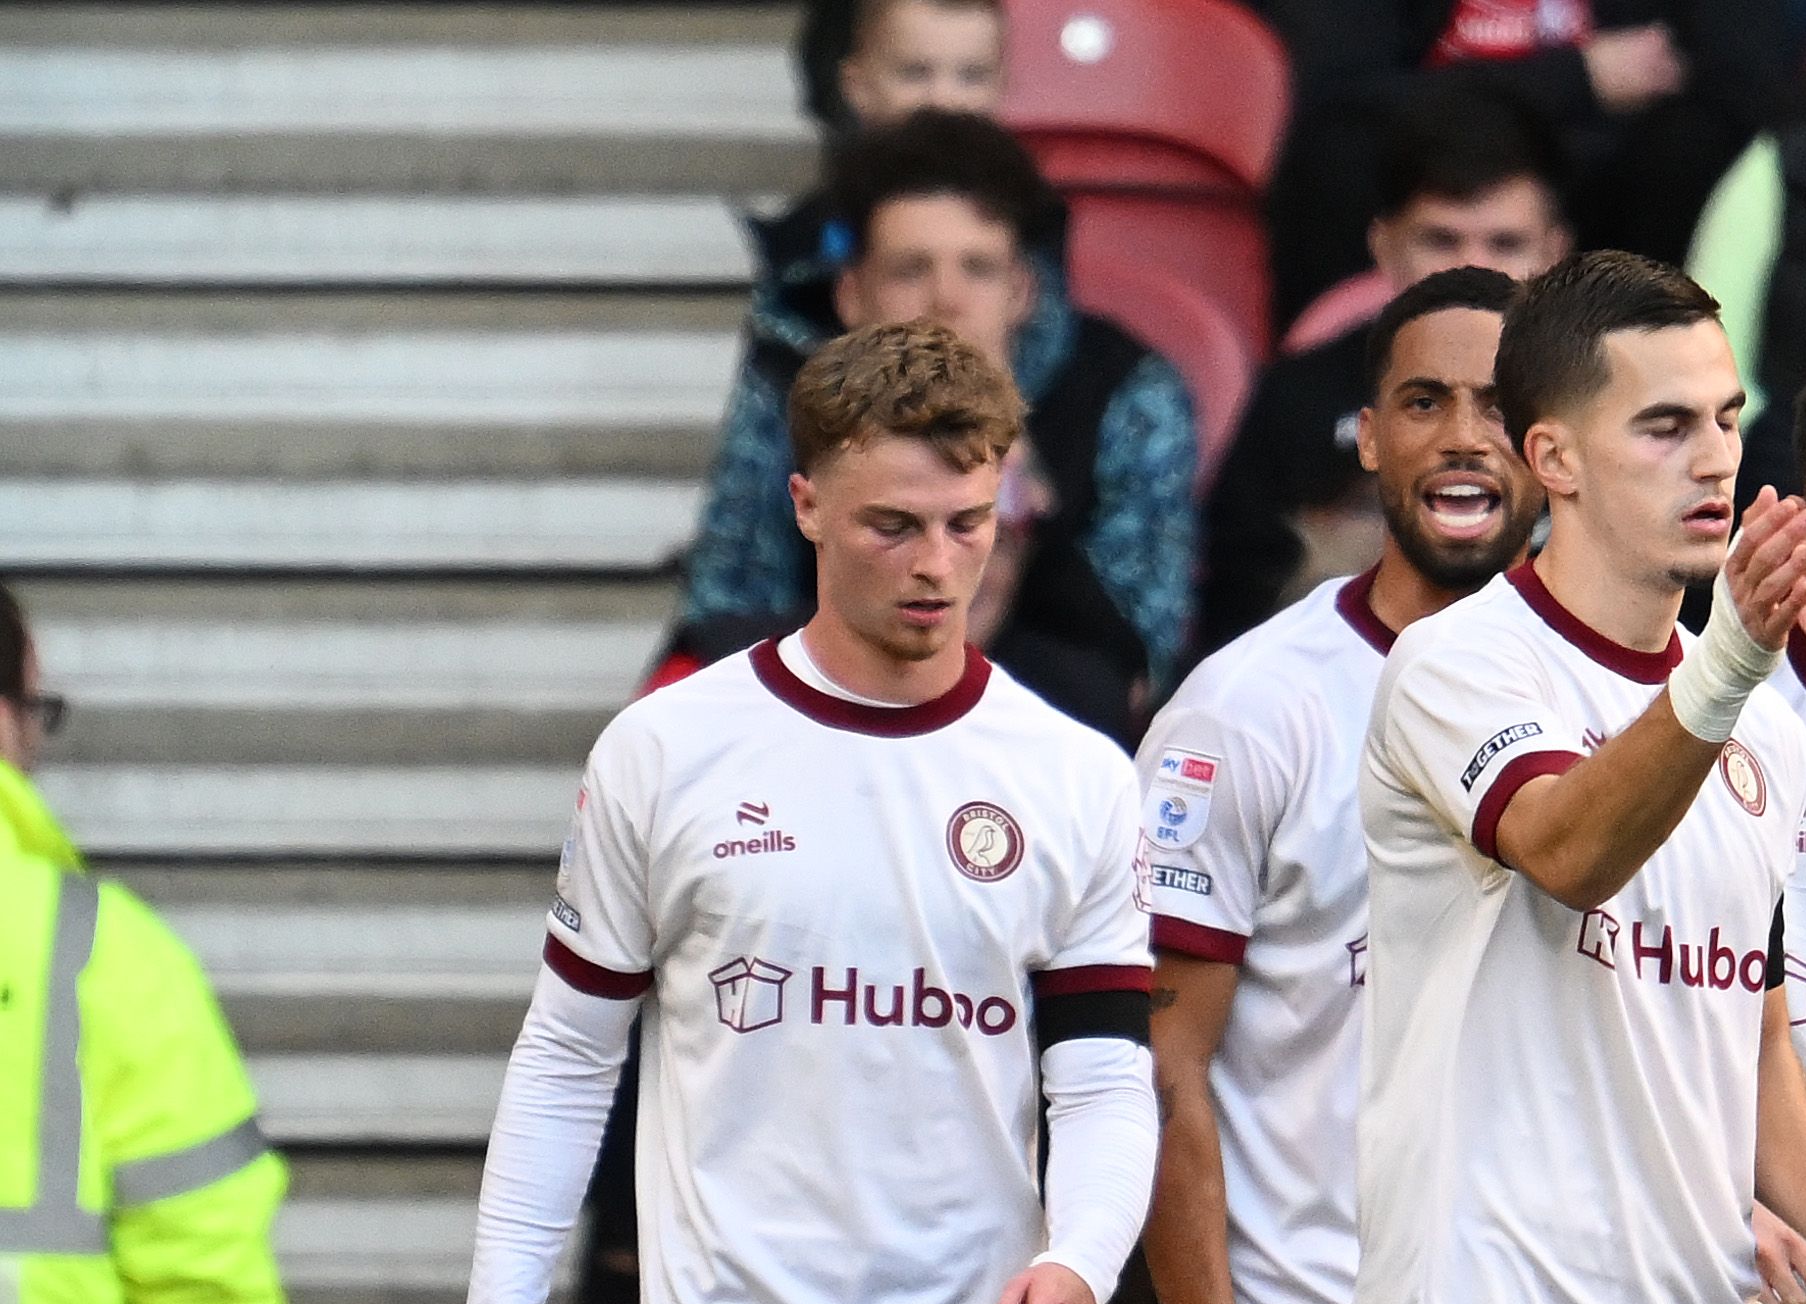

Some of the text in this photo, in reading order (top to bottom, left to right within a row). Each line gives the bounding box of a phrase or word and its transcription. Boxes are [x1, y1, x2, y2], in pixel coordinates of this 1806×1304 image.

[1462, 723, 1541, 785] TOGETHER
[962, 809, 1010, 830] BRISTOL
[712, 829, 797, 860] oneills
[965, 862, 995, 877] CITY
